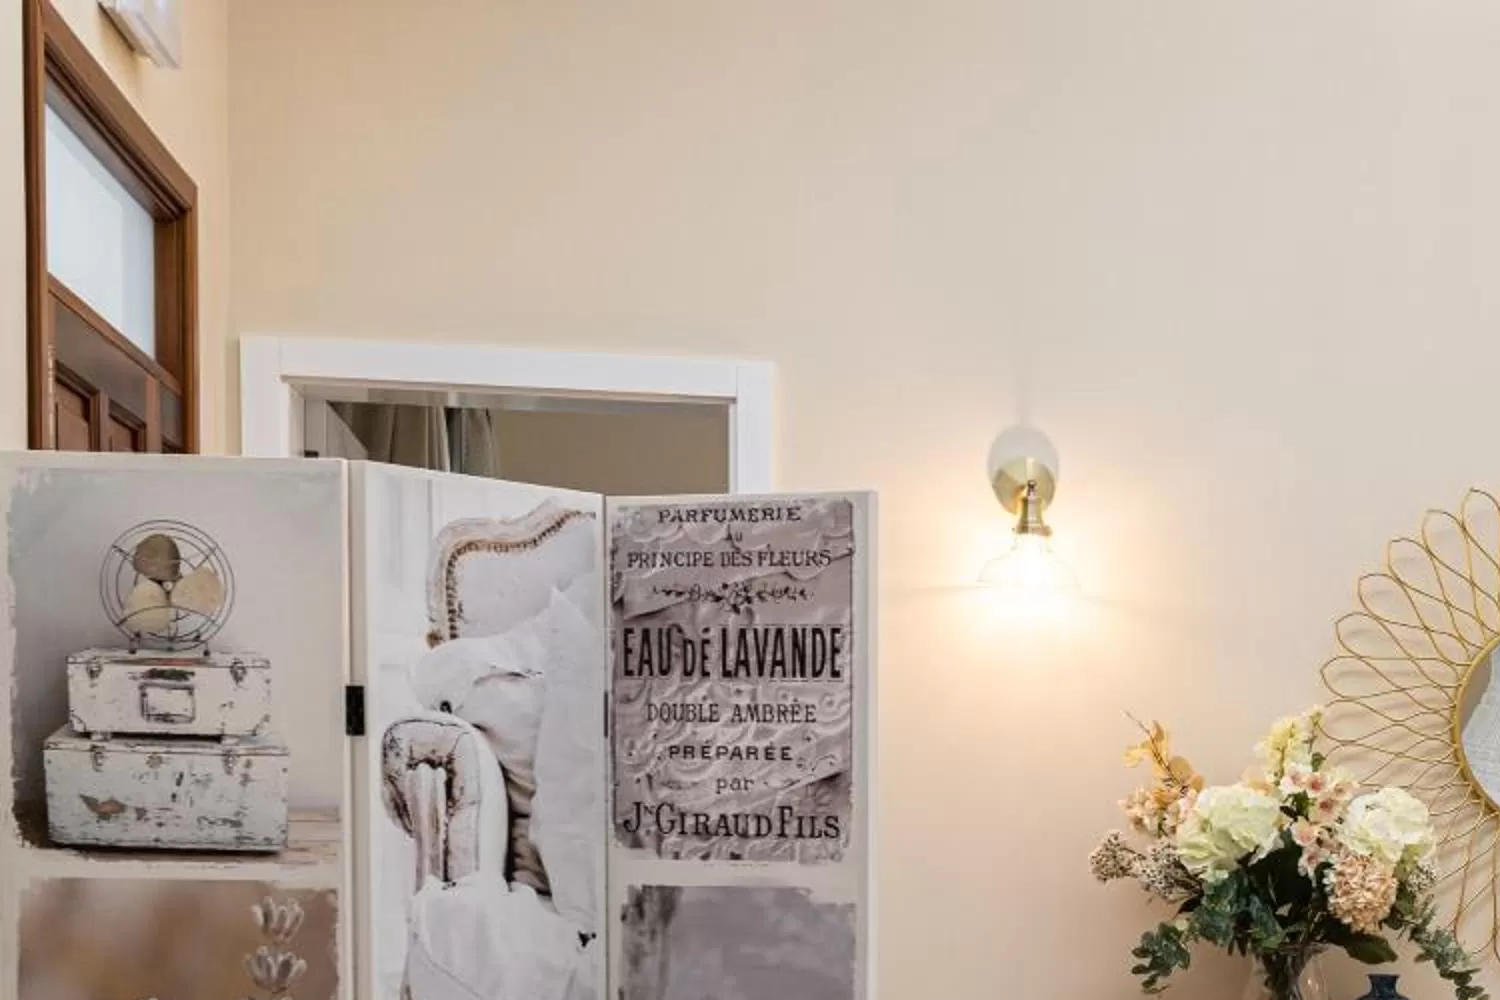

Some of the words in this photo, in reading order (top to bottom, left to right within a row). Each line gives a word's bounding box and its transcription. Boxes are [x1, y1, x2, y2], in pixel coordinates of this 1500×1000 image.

[658, 507, 801, 523] PARFUMERIE
[627, 552, 714, 568] PRINCIPE
[720, 551, 752, 567] DES
[757, 549, 832, 566] FLEURS
[623, 627, 672, 677] EAU
[721, 627, 842, 679] LAVANDE
[647, 703, 719, 723] DOUBLE
[730, 698, 816, 723] AMBRÉE
[715, 777, 754, 794] par
[655, 802, 772, 838] GIRAUD
[777, 805, 840, 839] FILS
